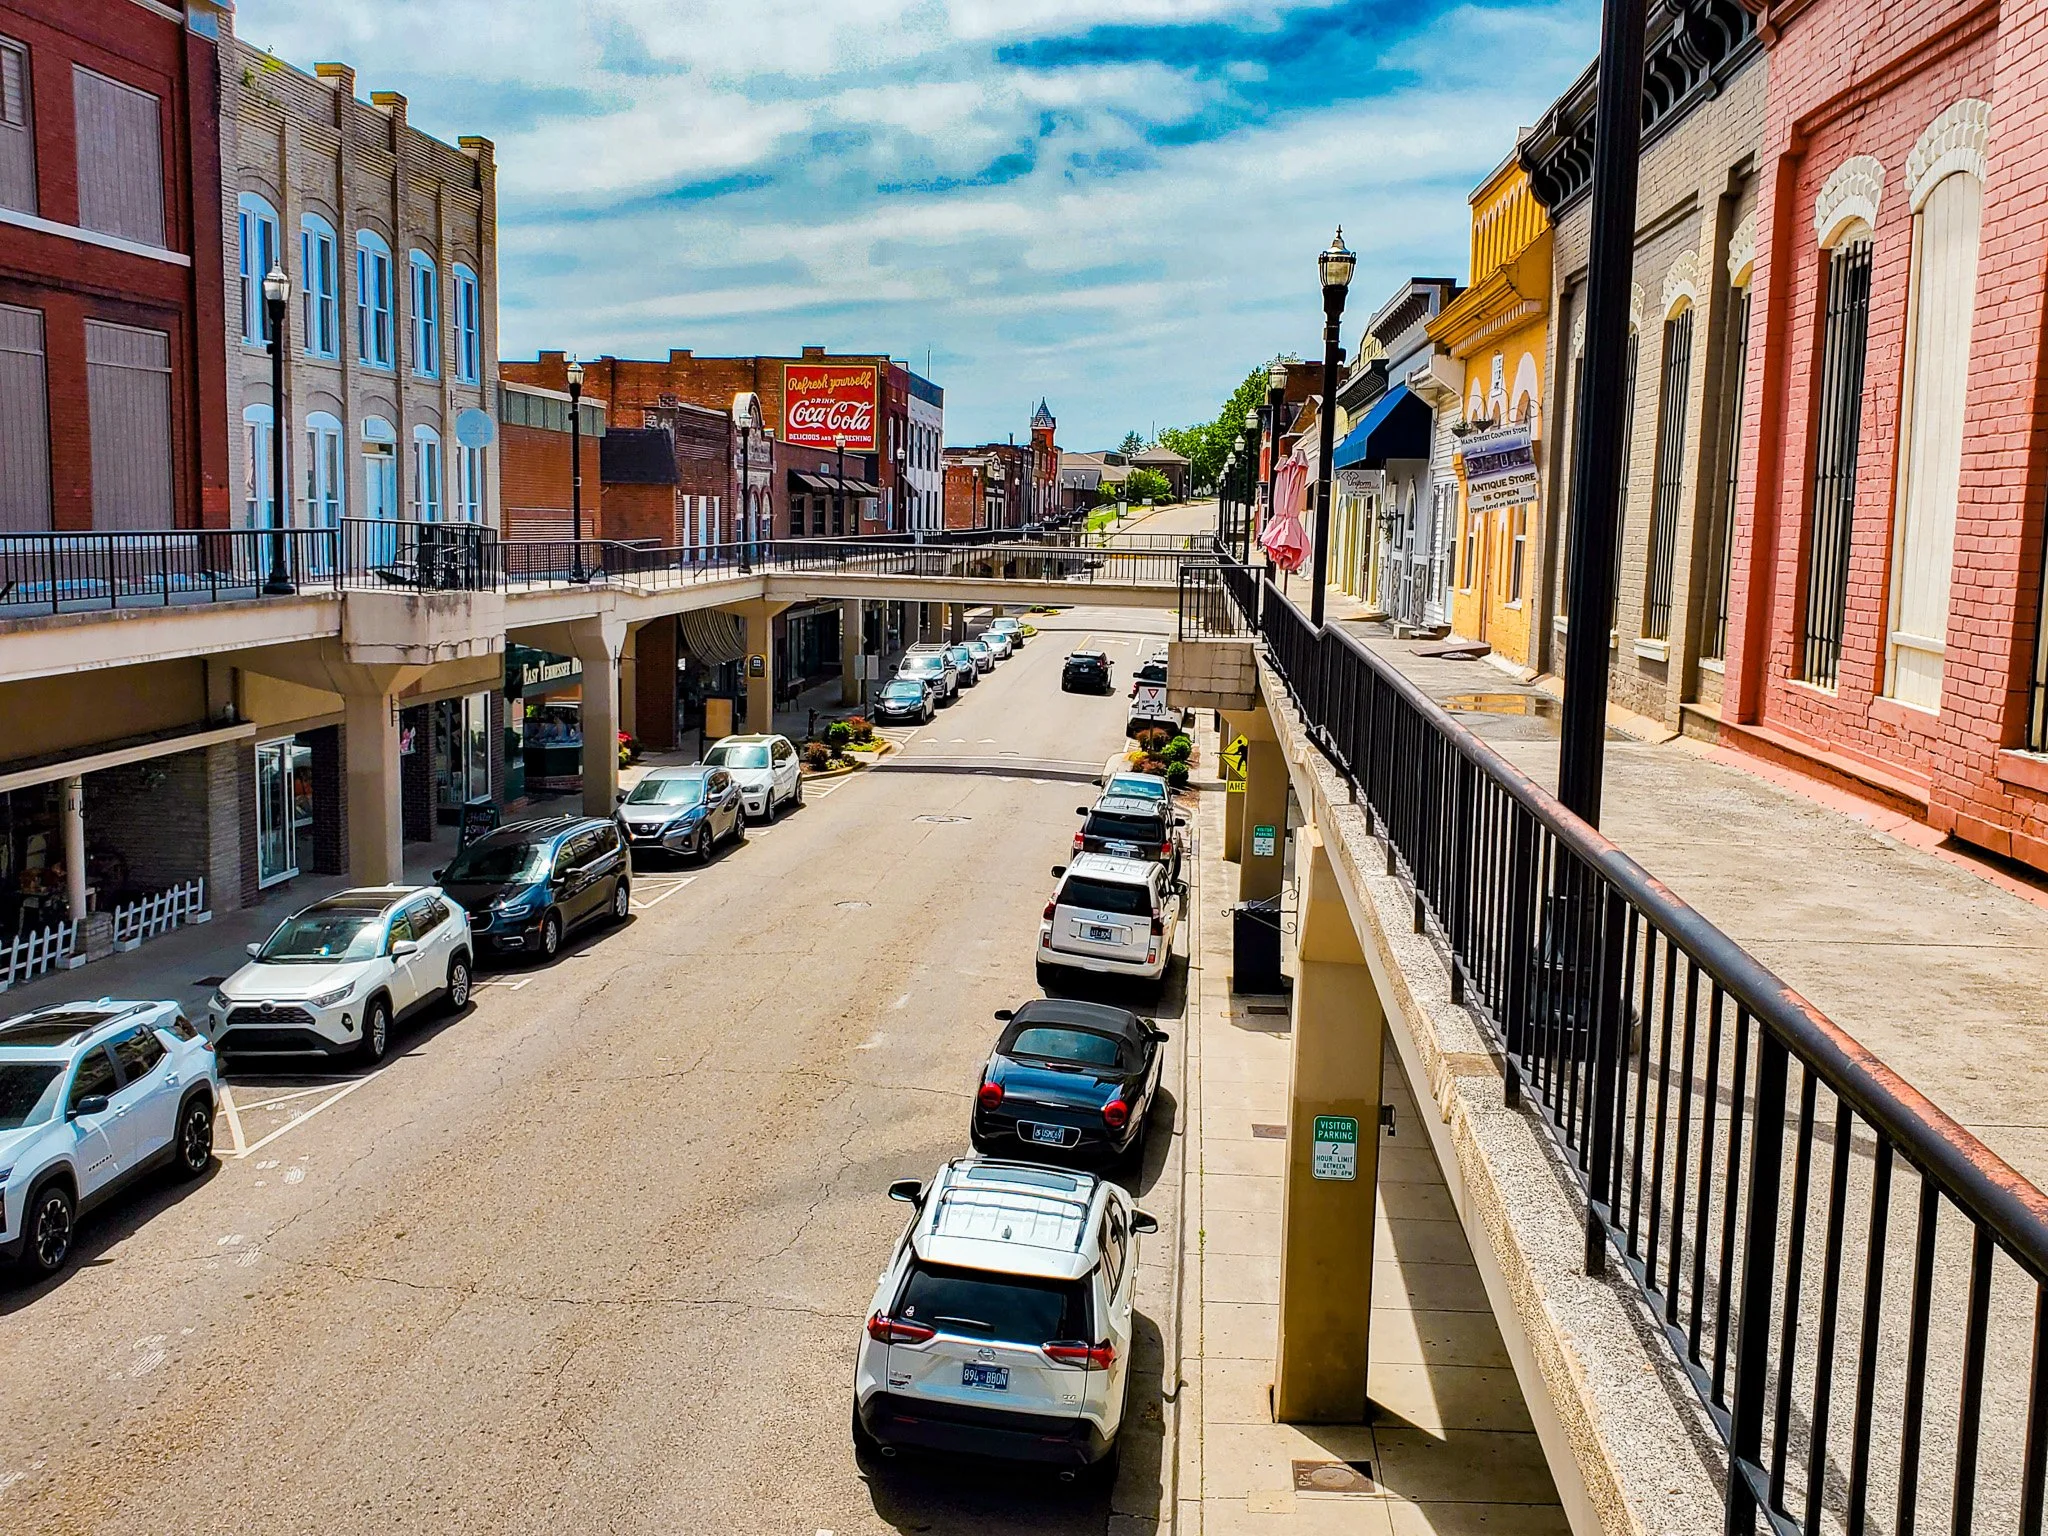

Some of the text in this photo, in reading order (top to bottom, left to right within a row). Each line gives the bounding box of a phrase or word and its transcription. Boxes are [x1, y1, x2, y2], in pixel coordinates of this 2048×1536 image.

[788, 373, 828, 395] Refresh
[789, 400, 874, 430] Coca-Cola
[788, 433, 820, 441] DELICIOUS
[1473, 434, 1490, 443] STREET
[1491, 430, 1512, 440] COUNTRY
[1512, 426, 1528, 435] STORE
[1471, 472, 1537, 493] ANTIQUE STORE
[1493, 488, 1520, 500] OPEN
[522, 663, 539, 685] EAST
[1320, 1120, 1352, 1131] VISITOR
[1318, 1130, 1353, 1140] PARKING
[1331, 1143, 1339, 1155] 2
[1316, 1154, 1333, 1162] HOUR
[1322, 1162, 1346, 1170] BETWEEN
[964, 1369, 979, 1382] 894
